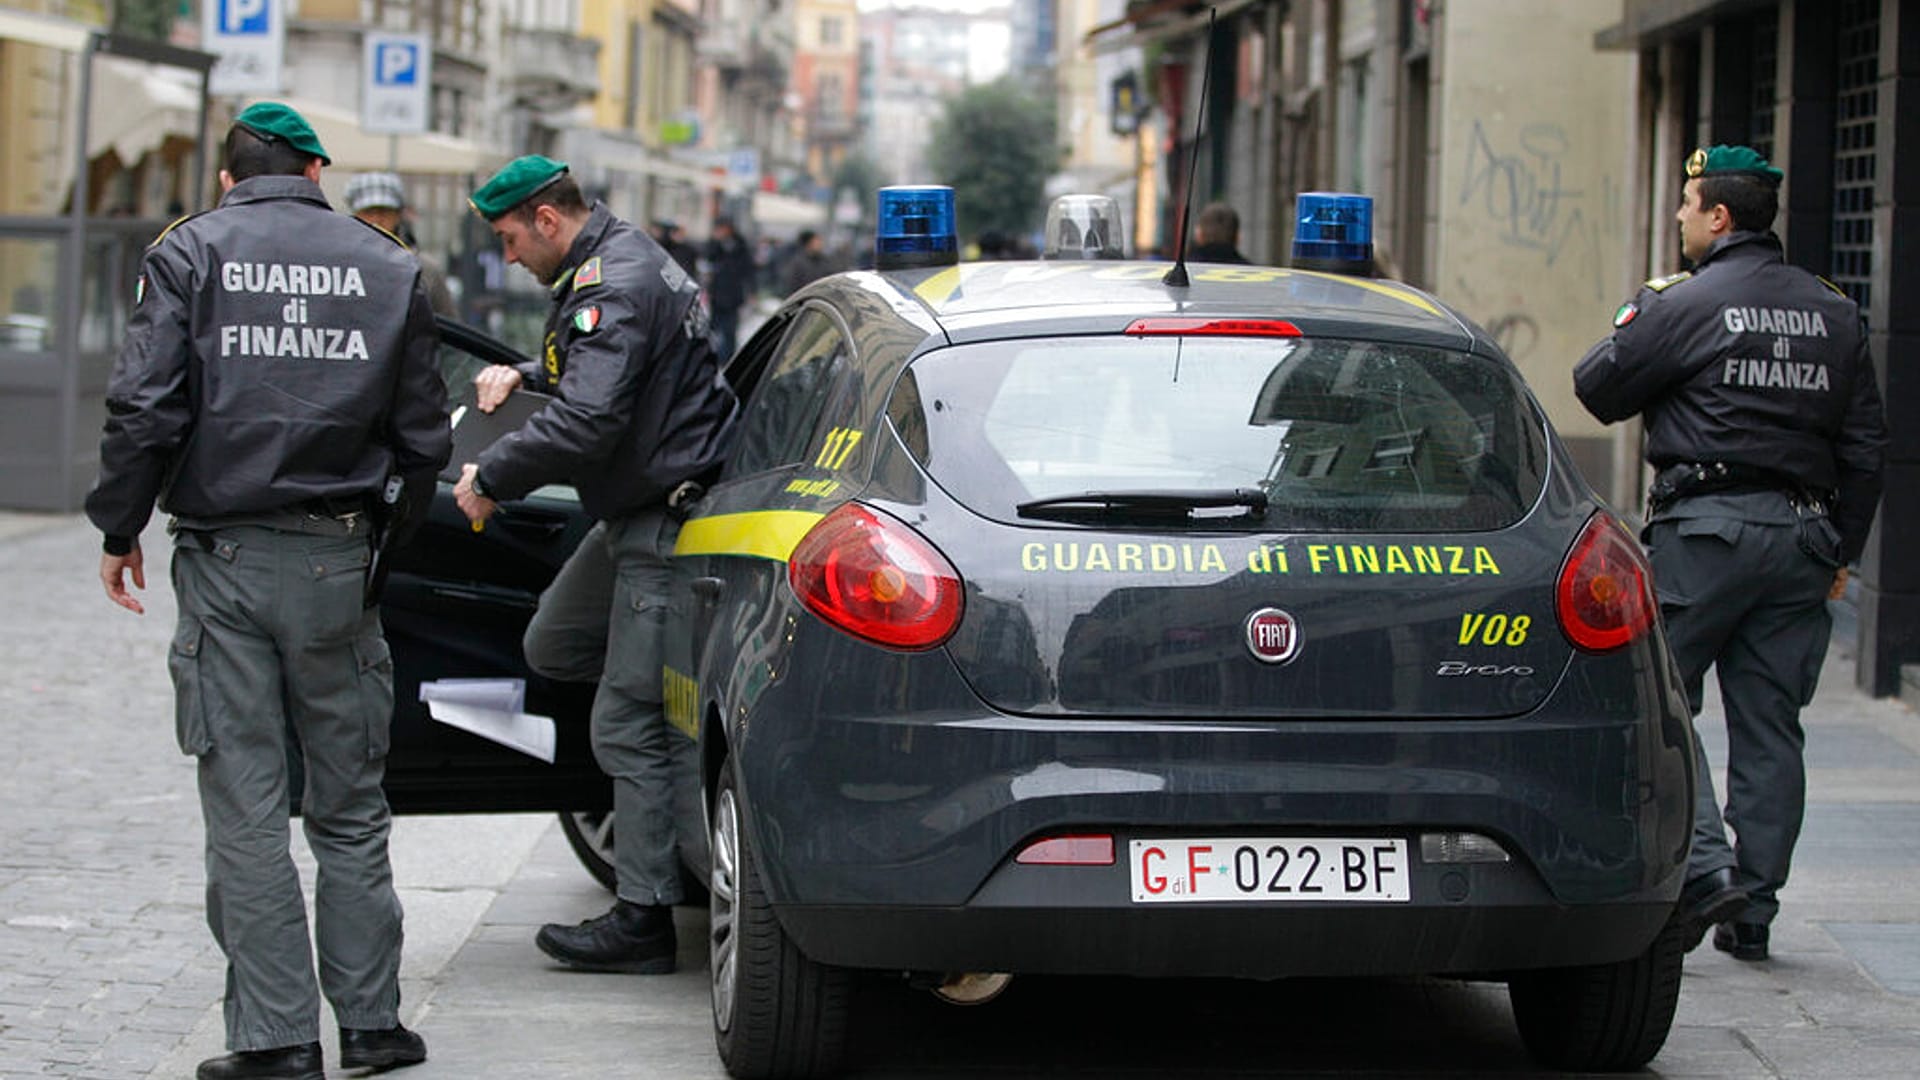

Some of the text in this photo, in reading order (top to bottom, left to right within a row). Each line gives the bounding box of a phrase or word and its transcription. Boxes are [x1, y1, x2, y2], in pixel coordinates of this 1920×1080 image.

[225, 0, 267, 32] P
[381, 46, 413, 83] P
[221, 261, 366, 297] GUARDIA
[282, 298, 307, 324] di
[1724, 306, 1828, 337] GUARDIA
[220, 325, 369, 361] FINANZA
[1773, 336, 1790, 359] di
[1722, 358, 1830, 391] FINANZA
[814, 426, 863, 470] 117
[1021, 542, 1501, 575] GUARDIA di FINANZA
[1257, 623, 1288, 648] FIAT
[1457, 613, 1532, 647] V08
[1436, 660, 1536, 677] Bravo
